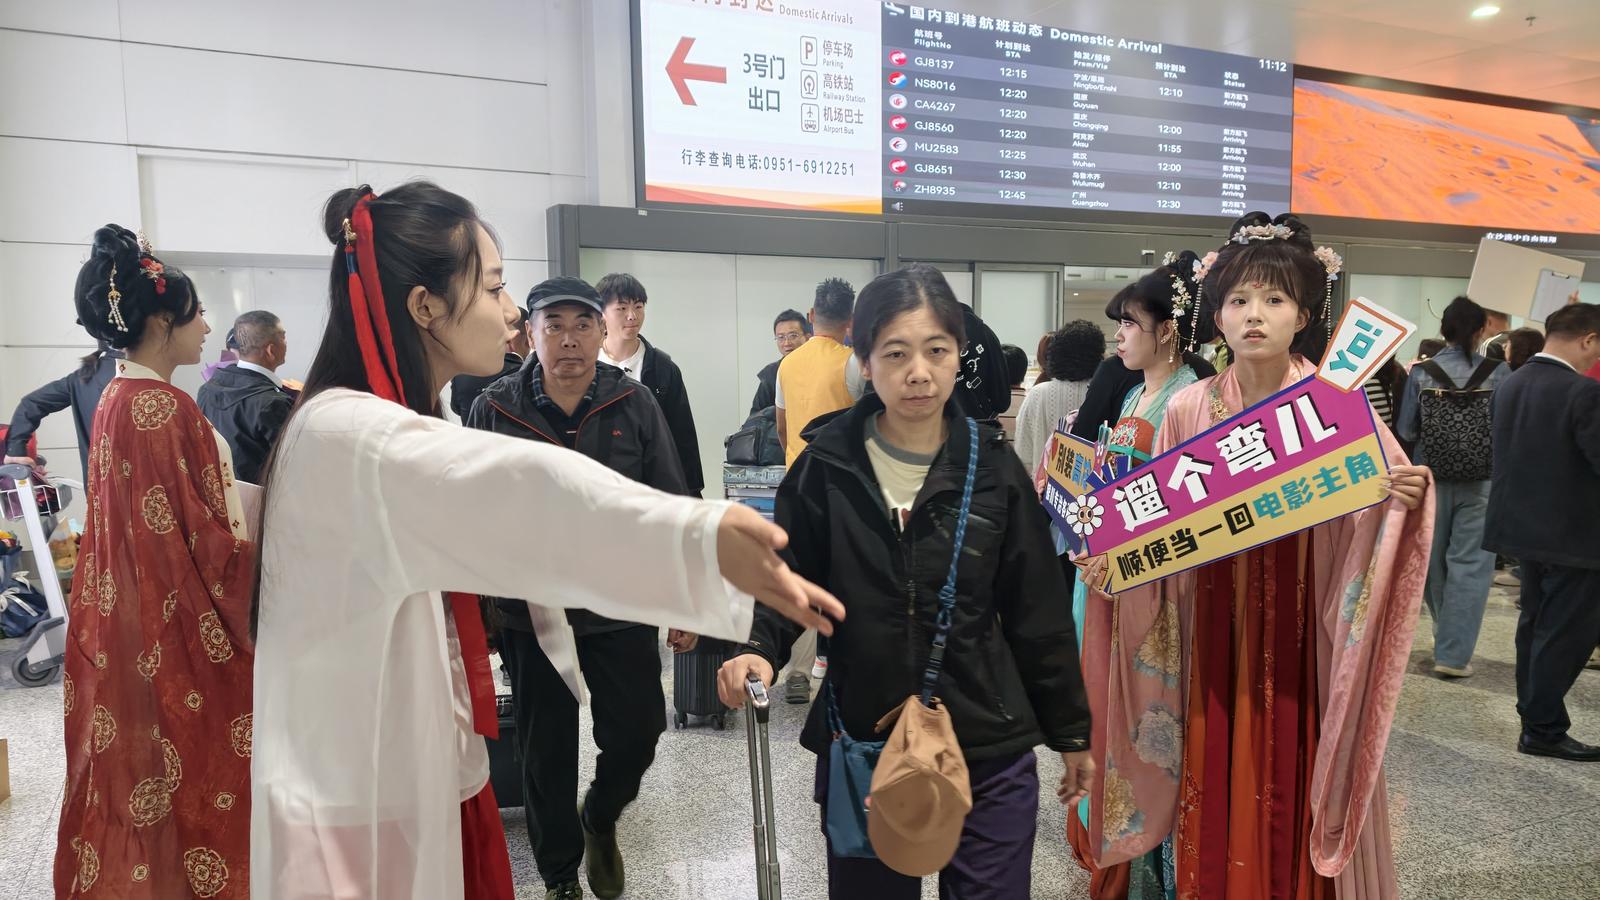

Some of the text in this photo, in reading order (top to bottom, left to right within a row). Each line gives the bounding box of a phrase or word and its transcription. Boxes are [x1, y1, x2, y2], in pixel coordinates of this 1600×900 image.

[779, 5, 820, 20] Domestic
[821, 10, 854, 25] Arrivals
[909, 5, 1043, 37] 国内到港航班动态
[914, 28, 943, 40] 航班号
[914, 38, 951, 49] FlightNo
[995, 40, 1031, 52] 计划到达
[1050, 28, 1162, 54] Domestic Arrival
[822, 39, 854, 58] 停车场
[1005, 51, 1021, 59] STA
[743, 53, 785, 80] 3号门
[823, 58, 844, 69] Parking
[914, 56, 954, 70] GJ8137
[1259, 59, 1287, 72] 11:12
[1000, 68, 1027, 79] 12:15
[822, 73, 854, 91] 高铁站
[914, 78, 956, 91] NS8016
[1224, 80, 1245, 88] Status
[823, 91, 866, 104] Railway Station
[1000, 88, 1027, 99] 12:20
[1159, 87, 1183, 97] 12:10
[749, 86, 781, 112] 出口
[1223, 100, 1246, 109] Arriving
[914, 100, 956, 112] CA4267
[1073, 101, 1098, 110] Guyuan
[823, 105, 864, 125] 机场巴士
[1000, 109, 1027, 120] 12:20
[823, 124, 854, 135] Airport Bus
[914, 121, 954, 133] GJ8560
[1073, 120, 1109, 132] Chongqing
[1158, 125, 1182, 135] 12:00
[1000, 129, 1027, 139] 12:20
[1072, 140, 1089, 148] Aksu
[1223, 136, 1245, 145] Arriving
[914, 142, 958, 154] MU2583
[1158, 143, 1182, 153] 11:55
[999, 150, 1026, 160] 12:25
[1222, 154, 1245, 163] Arriving
[914, 163, 953, 175] GJ8651
[1072, 160, 1096, 168] Wuhan
[1157, 163, 1181, 172] 12:00
[999, 170, 1026, 180] 12:30
[1222, 172, 1245, 181] Arriving
[1072, 179, 1105, 189] Wulumuqi
[1157, 181, 1181, 191] 12:10
[914, 184, 956, 196] ZH8935
[999, 190, 1026, 200] 12:45
[1072, 191, 1087, 199] 广州
[1222, 190, 1244, 199] Arriving
[1071, 199, 1109, 208] Guangzhou
[1156, 200, 1181, 209] 12:30
[1221, 208, 1244, 216] Arriving
[1111, 392, 1338, 532] 遛个弯儿
[1116, 451, 1379, 582] 顺便当一回电影主角
